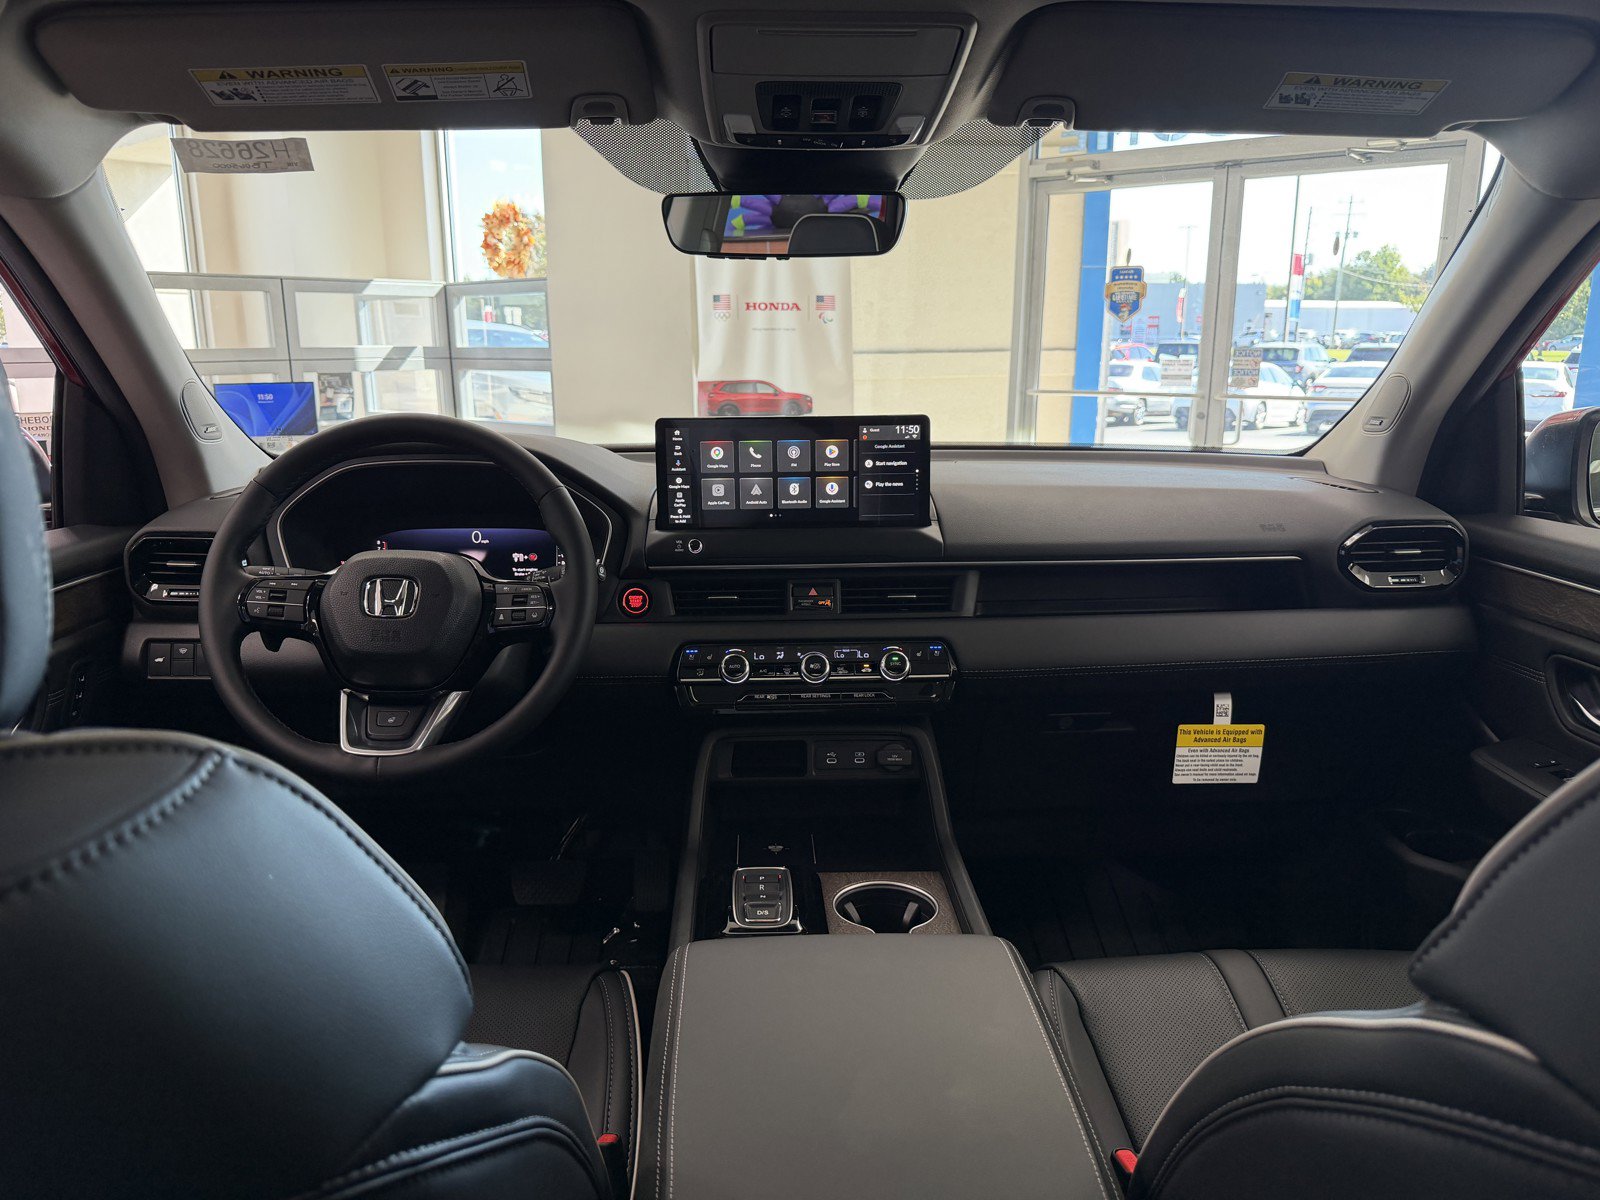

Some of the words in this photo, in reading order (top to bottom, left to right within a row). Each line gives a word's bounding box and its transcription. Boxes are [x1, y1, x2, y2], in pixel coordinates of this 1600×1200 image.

[246, 67, 343, 79] WARNING
[1333, 77, 1423, 90] WARNING
[744, 302, 802, 311] HONDA
[895, 425, 920, 434] 11:50
[471, 530, 482, 544] 0
[753, 652, 766, 661] Lo
[836, 651, 846, 659] Lo
[858, 651, 870, 659] Lo
[1222, 728, 1249, 737] Equipped
[1232, 736, 1247, 744] Bags
